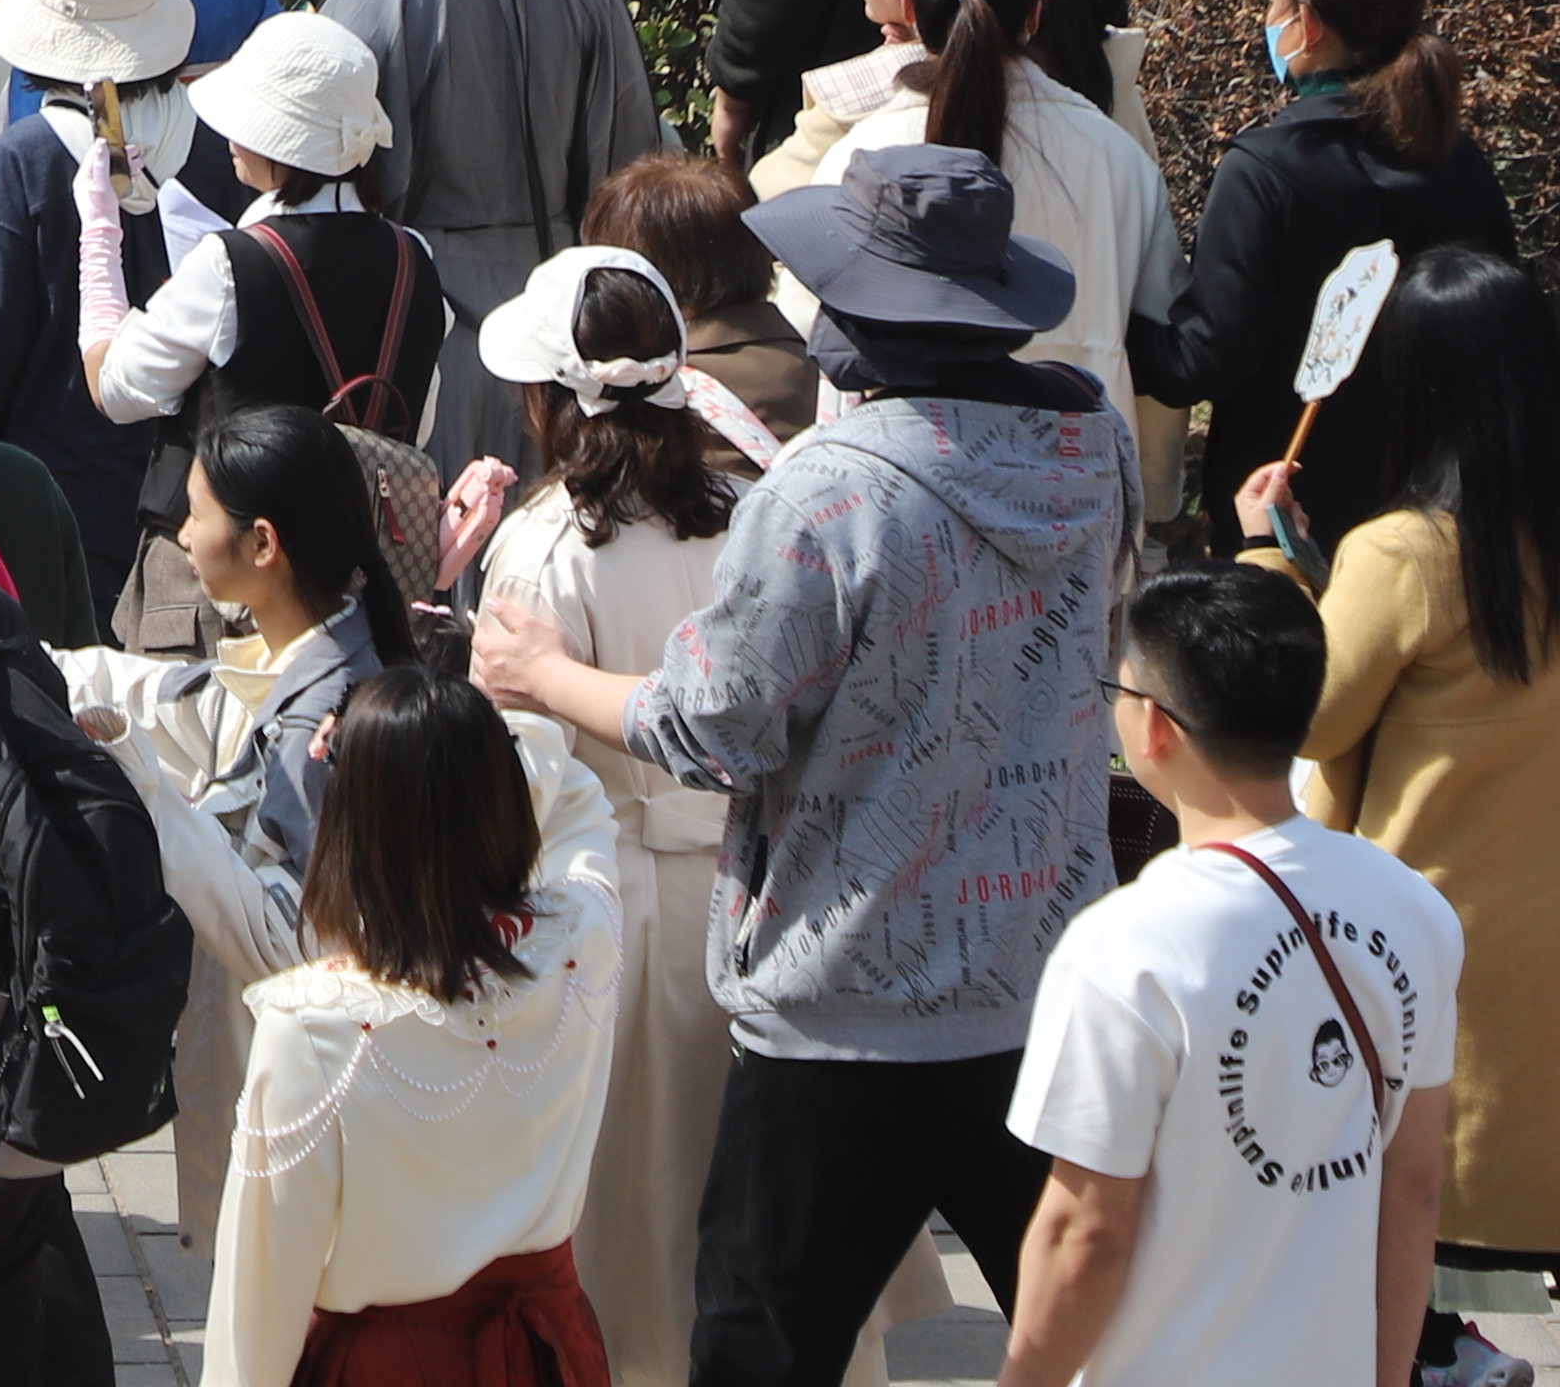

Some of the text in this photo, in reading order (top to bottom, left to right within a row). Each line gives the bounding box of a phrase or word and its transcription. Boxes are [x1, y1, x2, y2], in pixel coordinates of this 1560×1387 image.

[959, 590, 1044, 641] JORDAN
[1013, 572, 1090, 682] JORDAN
[675, 674, 762, 713] ORDAN
[788, 876, 868, 969] JORDAN
[956, 864, 1057, 905] JORDAN
[1032, 844, 1097, 953] JORDAN
[1236, 910, 1358, 1016] Supinife
[1219, 1028, 1285, 1188] Supinlife
